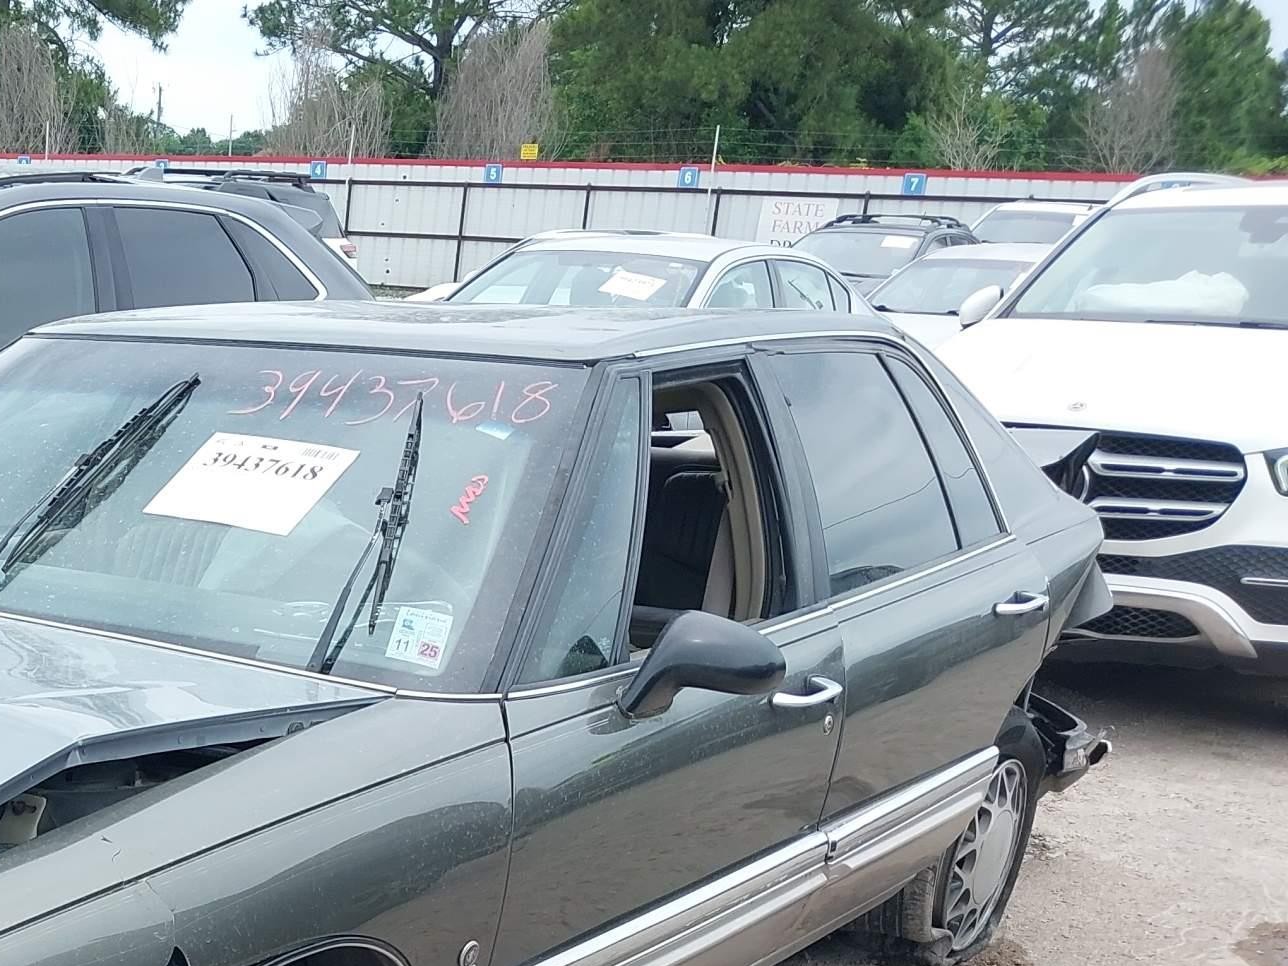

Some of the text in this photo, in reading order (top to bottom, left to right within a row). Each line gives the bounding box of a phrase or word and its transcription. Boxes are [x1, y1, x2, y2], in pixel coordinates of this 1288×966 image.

[489, 168, 497, 180] 5
[684, 171, 692, 185] 6
[910, 178, 919, 192] 7
[772, 201, 825, 217] STATE
[771, 219, 820, 234] FARM
[227, 368, 559, 425] 39437618
[202, 452, 324, 480] 39437618
[395, 638, 439, 658] 11 25
